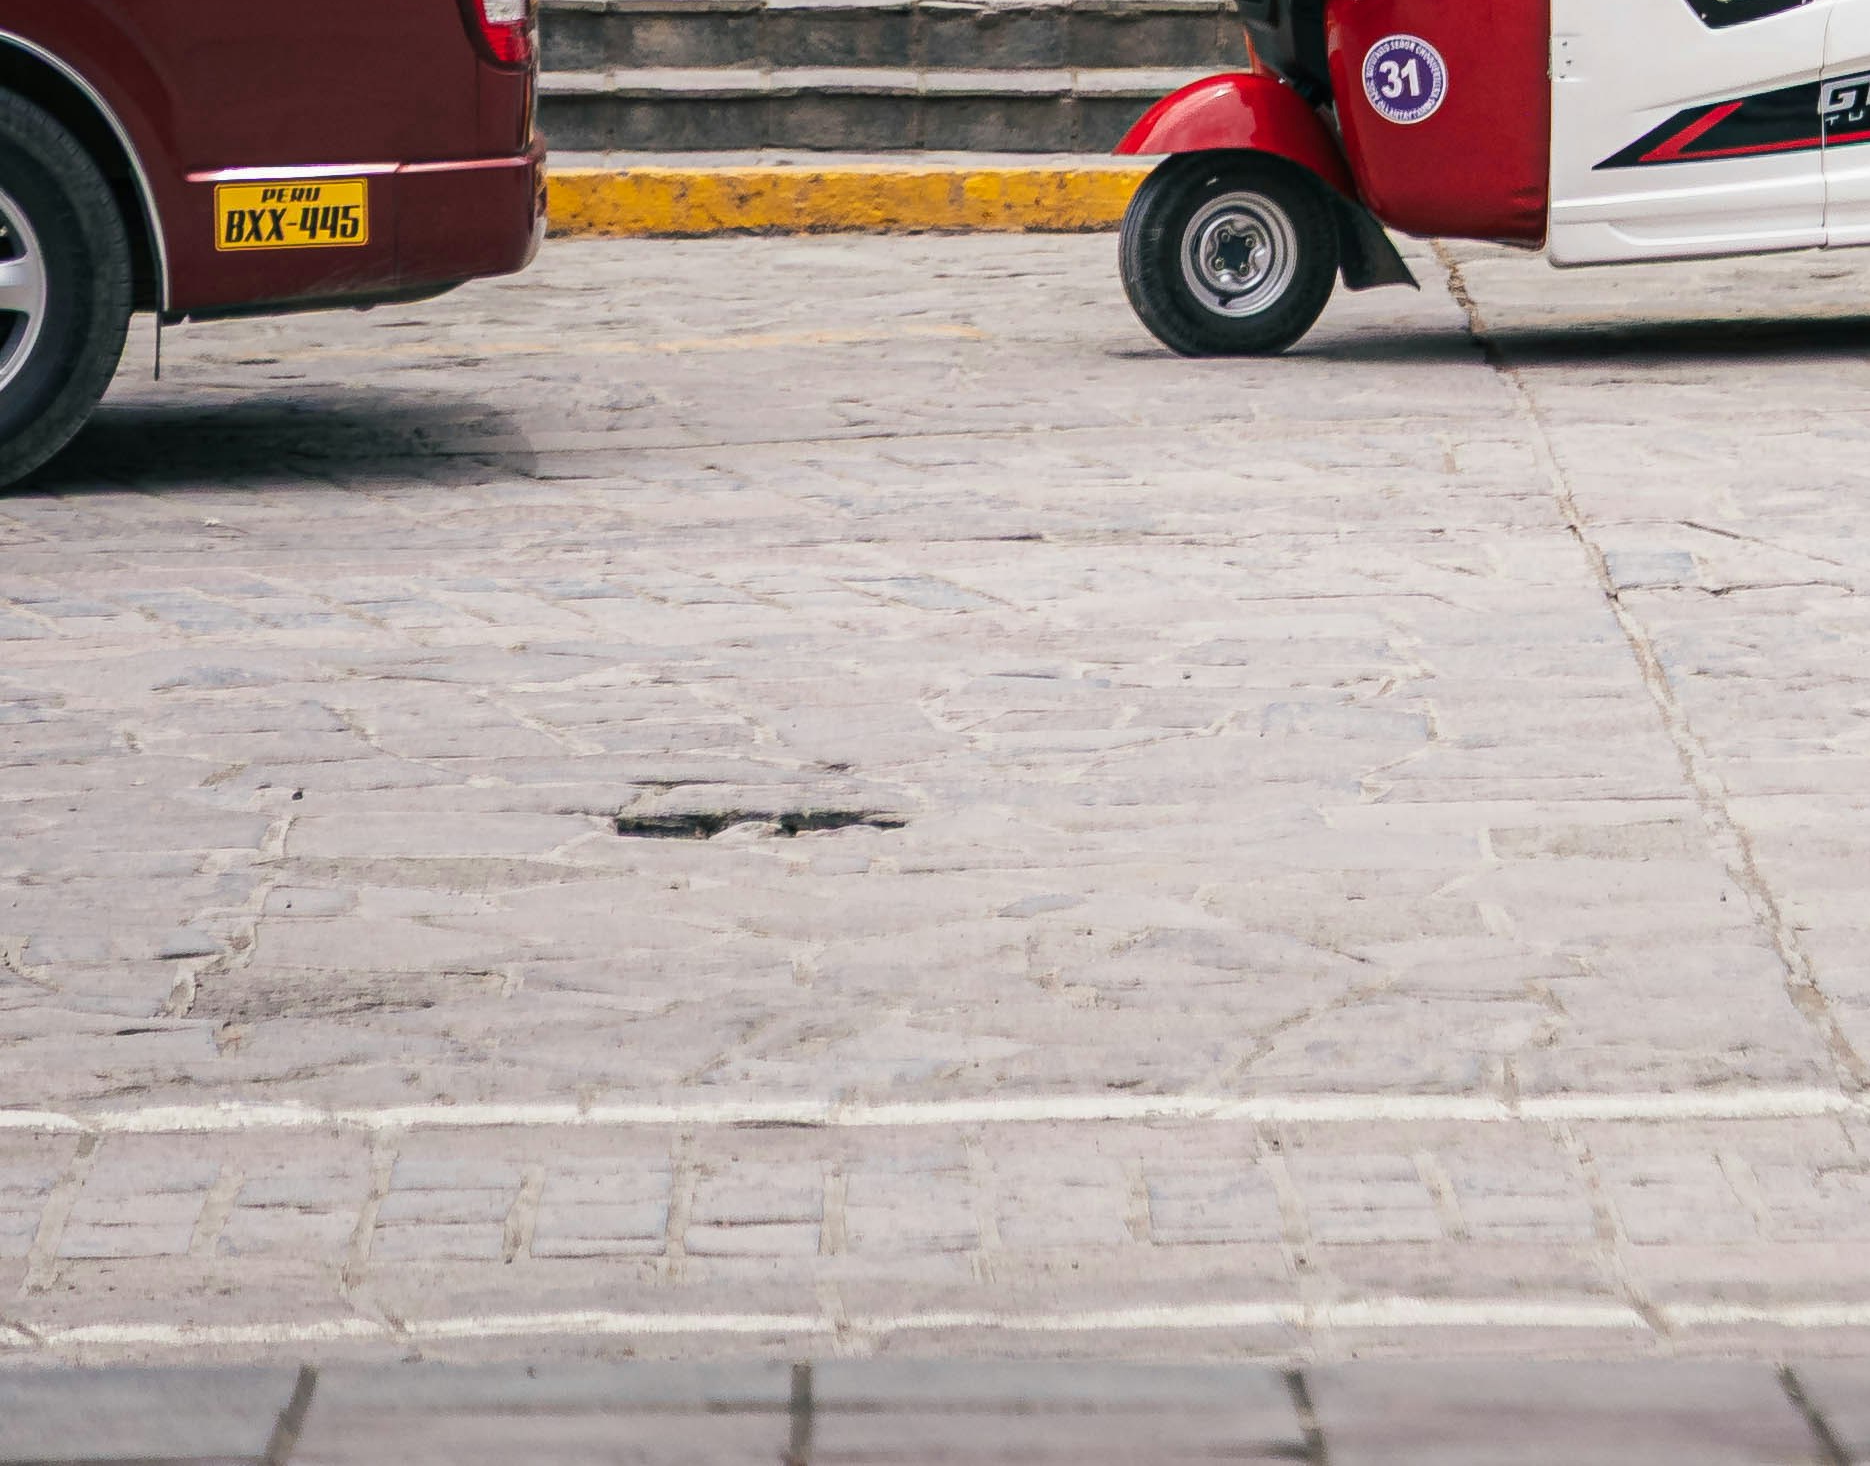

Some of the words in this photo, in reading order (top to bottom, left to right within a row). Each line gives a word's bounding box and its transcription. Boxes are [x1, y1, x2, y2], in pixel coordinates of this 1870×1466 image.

[1379, 57, 1421, 99] 31
[261, 187, 321, 203] PERU
[225, 205, 361, 243] BXX-445
